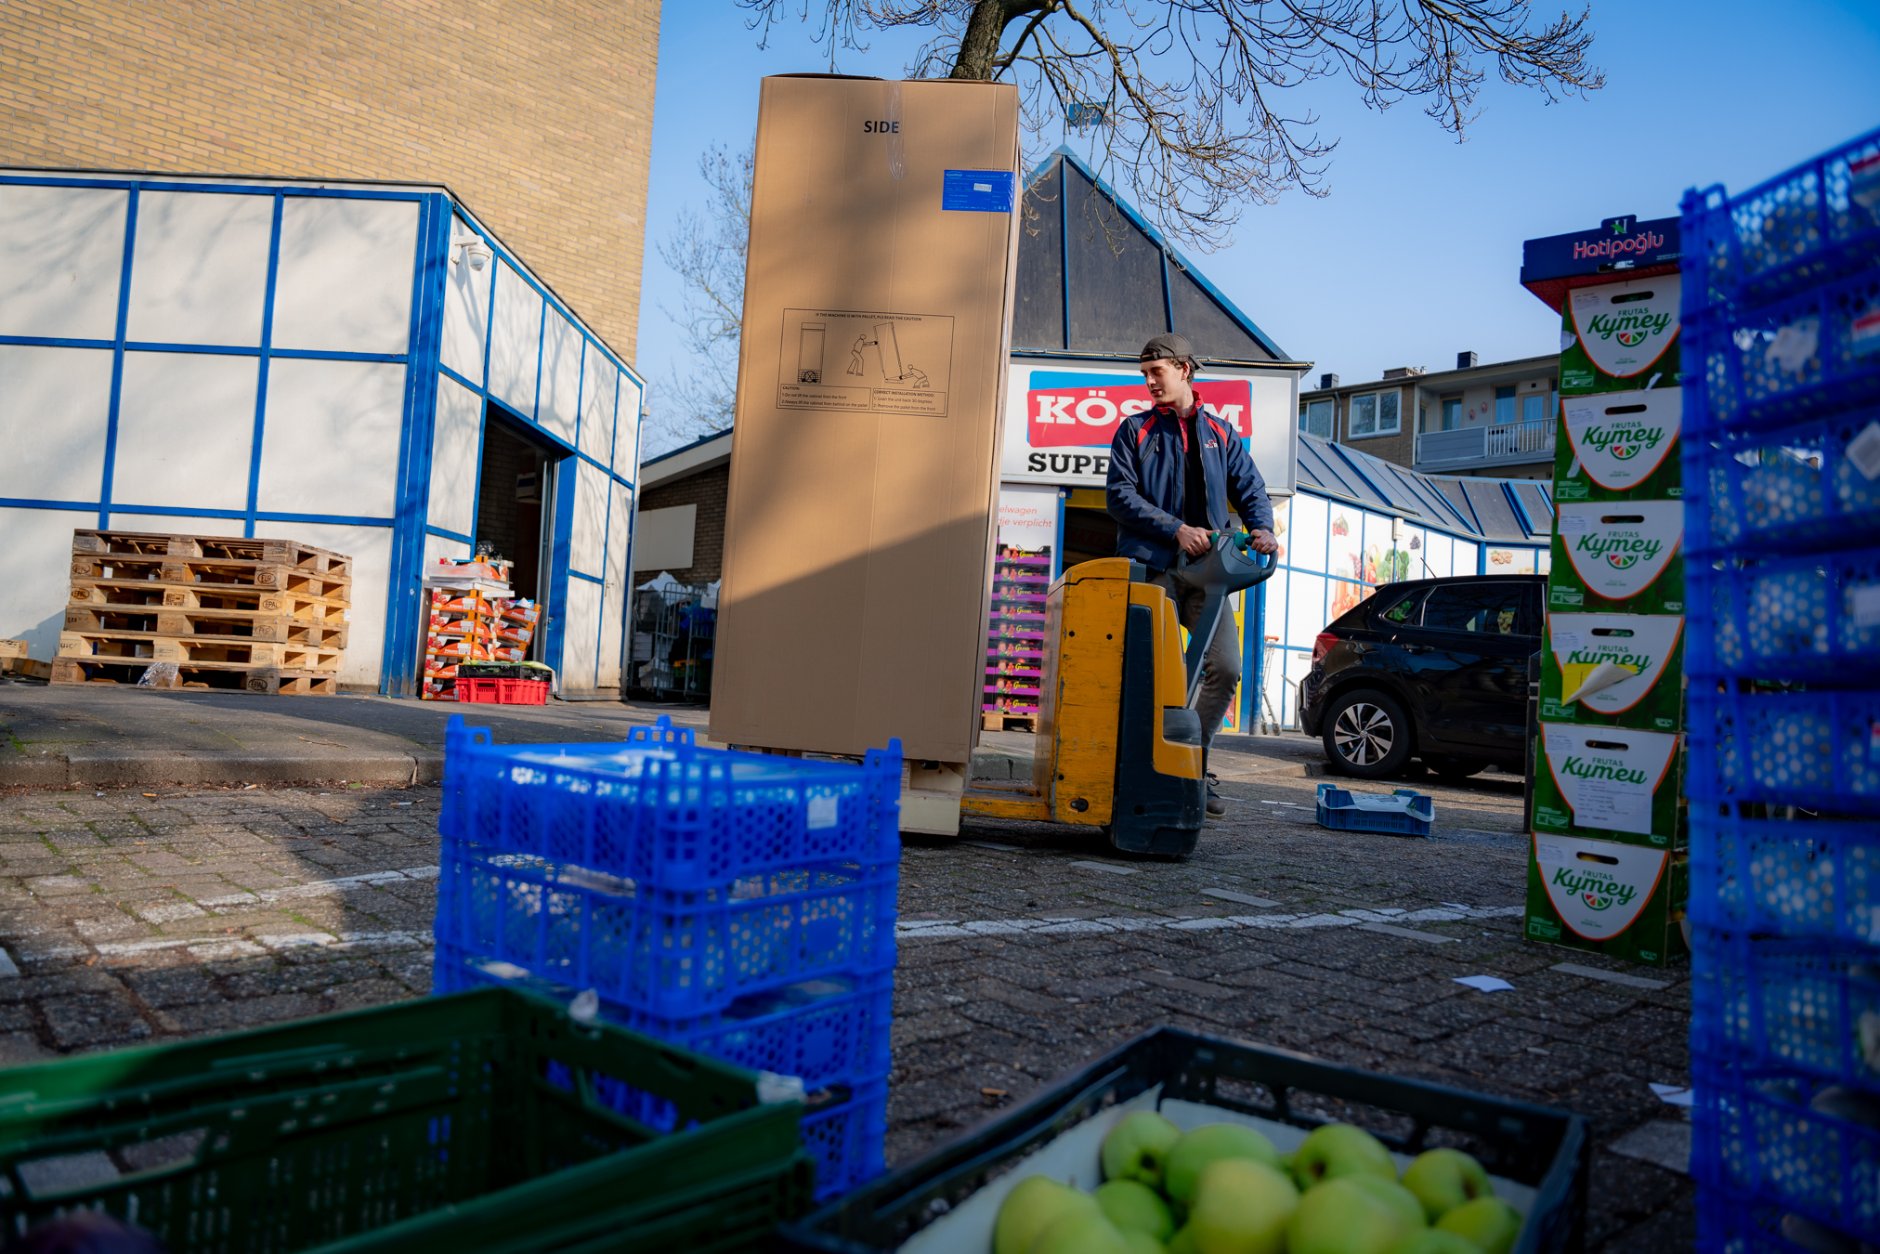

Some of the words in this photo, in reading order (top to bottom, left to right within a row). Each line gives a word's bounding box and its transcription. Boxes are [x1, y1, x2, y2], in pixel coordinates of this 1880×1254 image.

[864, 120, 899, 133] SIDE
[1573, 230, 1664, 260] Hatipoğlu
[1618, 307, 1649, 316] FRUTAS
[1586, 312, 1672, 340] Kymey
[1036, 390, 1243, 432] KÖSM
[1582, 426, 1664, 452] Kymey
[1028, 452, 1110, 474] SUPE
[998, 505, 1038, 516] elwagen
[1576, 533, 1663, 560] Kymey
[1598, 644, 1629, 652] FRUTAS
[1592, 757, 1623, 766] FRUTAS
[1582, 870, 1614, 880] FRUTAS
[1552, 868, 1638, 905] Kymey
